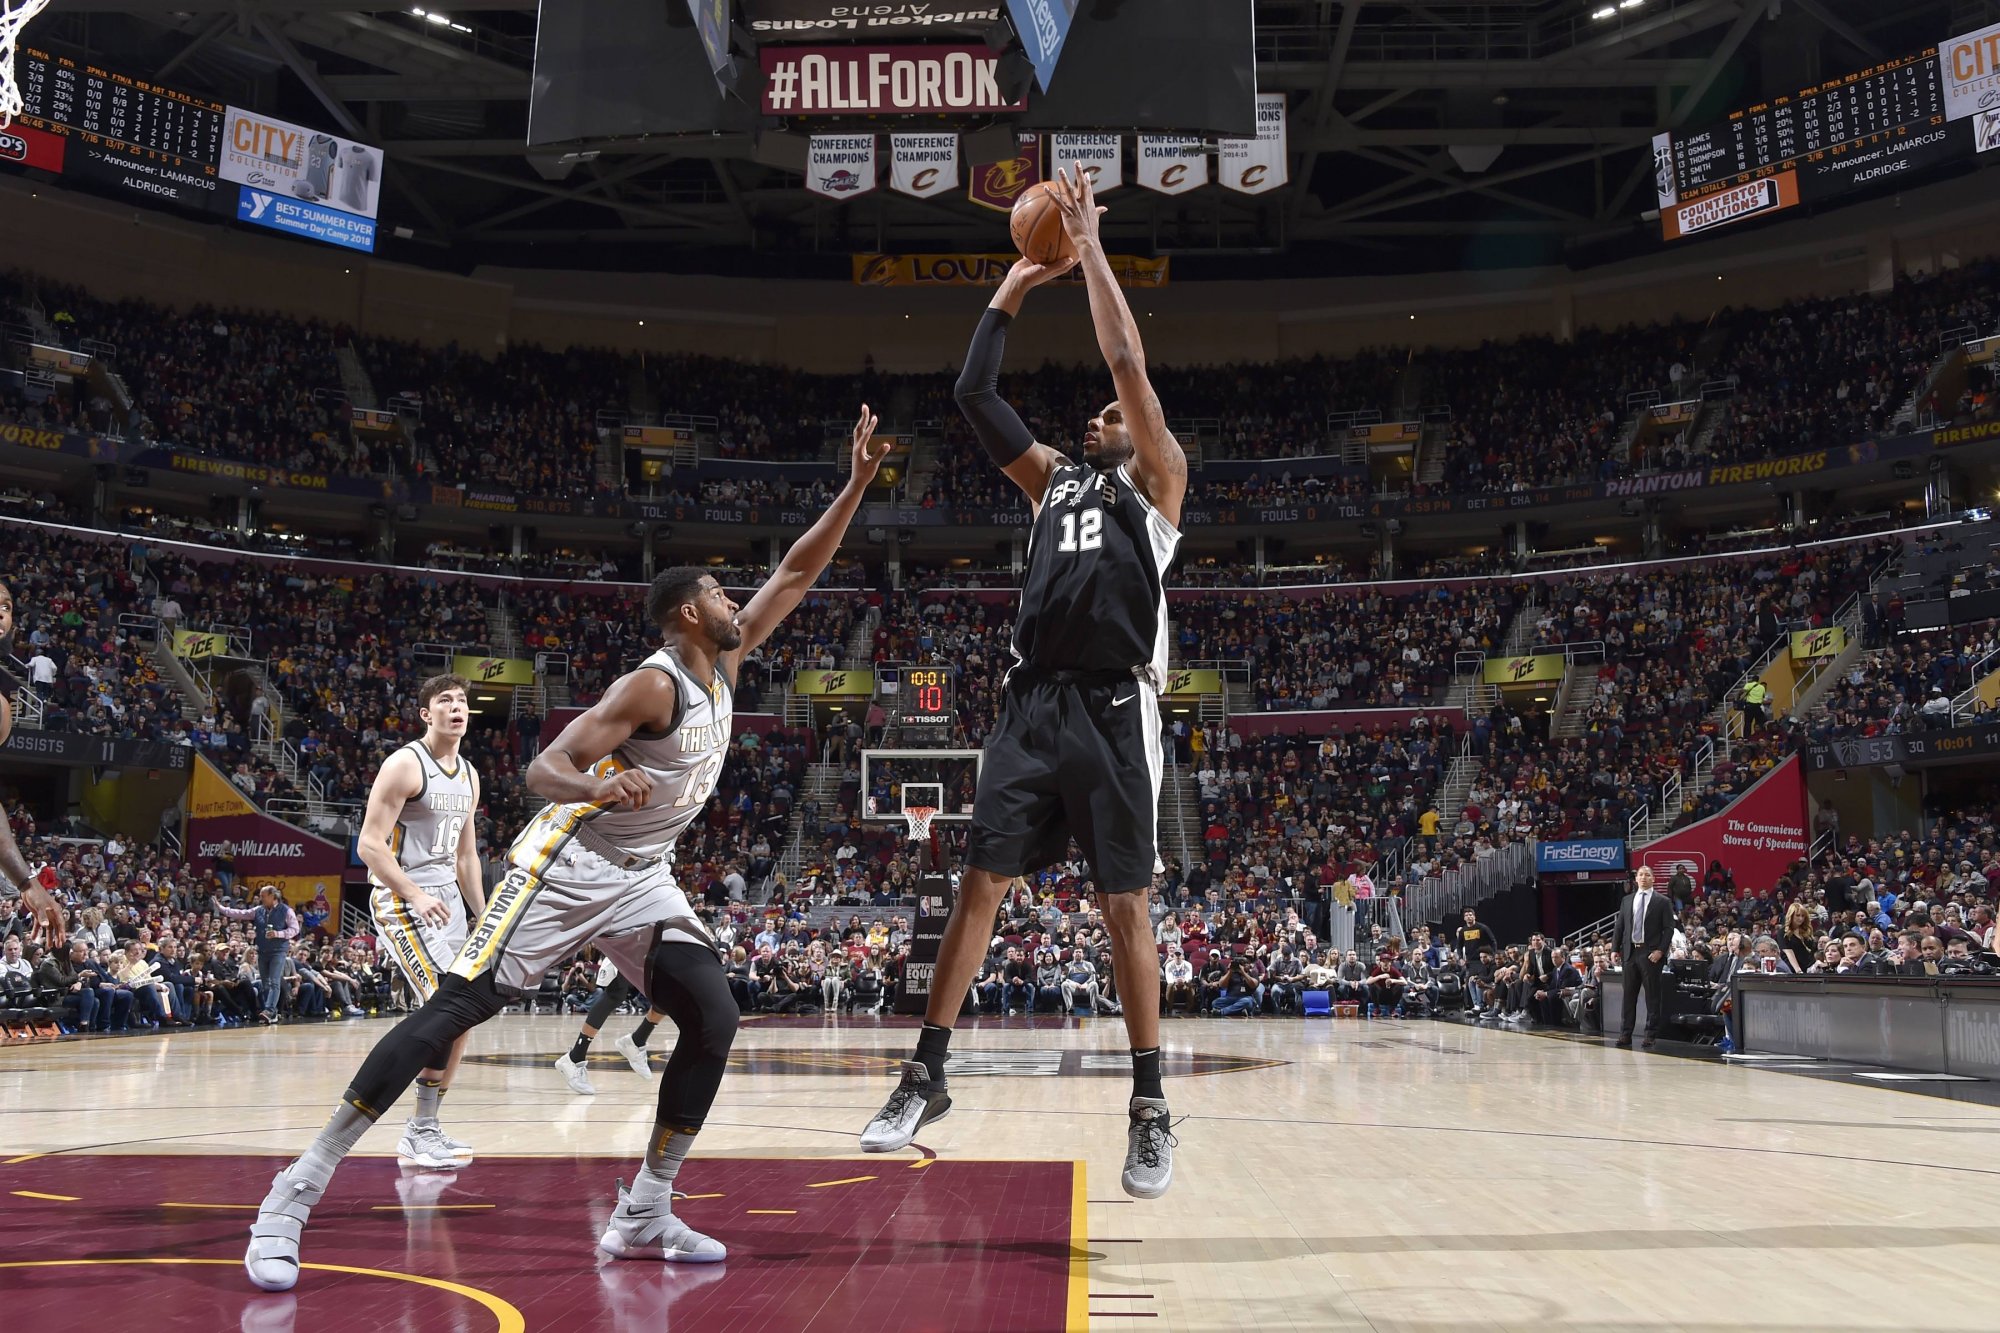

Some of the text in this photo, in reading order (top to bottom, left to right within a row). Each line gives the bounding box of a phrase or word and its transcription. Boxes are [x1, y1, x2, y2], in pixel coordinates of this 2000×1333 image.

[831, 2, 929, 16] Arena
[752, 18, 848, 32] Loans
[28, 61, 103, 89] 2/5 40% 0/0
[28, 72, 44, 82] 3/9
[55, 80, 74, 92] 33%
[768, 52, 1020, 109] #ALLFORON
[28, 83, 73, 102] 1/3 33%
[24, 104, 68, 122] 0/5 0%
[26, 93, 98, 120] 2/7 29% 1/5
[1674, 141, 1684, 150] 23
[1687, 132, 1710, 146] JAMES
[1732, 122, 1743, 132] 20
[1775, 107, 1792, 118] 64%
[1802, 98, 1816, 109] 2/3
[1827, 92, 1838, 102] 1/2
[1926, 60, 1934, 70] 17
[234, 118, 296, 162] CITY
[1056, 134, 1118, 146] CONFERENCE
[1676, 152, 1684, 160] 16
[1688, 142, 1712, 156] OSMAN
[1776, 117, 1793, 128] 20%
[1827, 101, 1842, 112] 2/3
[1678, 160, 1686, 168] 13
[1690, 148, 1726, 166] THOMPSON
[1736, 142, 1744, 151] 16
[1777, 127, 1794, 138] 50%
[1804, 119, 1819, 130] 0/0
[1828, 112, 1842, 122] 0/0
[1850, 106, 1860, 115] 12
[811, 138, 872, 149] CONFERENCE
[894, 136, 955, 148] CONFERENCE
[1690, 162, 1712, 176] SMITH
[1806, 130, 1820, 140] 0/5
[1830, 122, 1844, 132] 0/0
[1832, 130, 1946, 171] Announcer: LAMARCUS
[813, 152, 870, 164] CHAMPIONS
[896, 151, 952, 162] CHAMPIONS
[1058, 148, 1114, 160] CHAMPIONS
[1691, 174, 1706, 186] HILL
[1830, 132, 1845, 142] 0/0
[104, 154, 216, 190] Announcer: LAMARCUS
[229, 153, 298, 178] COLLECTION
[1853, 160, 1910, 183] ALDRIDGE.
[122, 176, 180, 198] ALDRIDGE.
[1680, 188, 1699, 200] TEAM
[1700, 181, 1727, 195] TOTALS
[242, 201, 252, 210] the
[1680, 182, 1766, 220] COUNTERTOP
[276, 202, 373, 235] BEST SUMMER EVER
[1688, 196, 1759, 228] SOLUTIONS
[275, 214, 371, 246] Summer Day Camp 2018
[0, 425, 64, 450] ORKS
[172, 454, 328, 488] FIREWORKS COM
[1605, 452, 1828, 497] PHANTOM FIREWORKS
[464, 500, 520, 512] FIREWORKS
[468, 492, 516, 504] PHANTOM
[1433, 500, 1450, 512] PM
[1467, 498, 1488, 510] DET
[1510, 495, 1531, 506] CHA
[641, 506, 684, 520] TOL: 5
[704, 509, 742, 522] FOULS
[780, 512, 806, 524] FG%
[898, 512, 918, 524] 53
[991, 512, 1032, 524] 10:01
[1186, 510, 1237, 524] FG% 34
[1260, 508, 1299, 522] FOULS
[1338, 504, 1382, 518] TOL: 4
[1058, 508, 1102, 552] 12
[190, 637, 214, 656] ICE
[1809, 630, 1832, 656] ICE
[483, 661, 506, 680] ICE
[911, 671, 946, 686] 10:01
[1514, 658, 1536, 681] ICE
[825, 673, 847, 694] ICE
[1171, 672, 1192, 692] ICE
[919, 686, 942, 711] 10
[914, 716, 949, 724] TISSOT
[6, 736, 64, 754] ASSISTS
[680, 726, 707, 752] THE
[1908, 740, 1925, 754] 3Q
[1935, 736, 1974, 752] 10:01
[1985, 734, 1998, 744] 11
[102, 742, 115, 762] 11
[1869, 741, 1894, 762] 53
[169, 755, 185, 768] 35
[672, 751, 722, 807] 13
[214, 801, 226, 812] THE
[226, 800, 245, 812] TOWN
[428, 792, 448, 812] THE
[429, 815, 462, 854] 16
[1728, 819, 1803, 836] The Convenience
[1544, 844, 1618, 860] FirstEnergy
[1722, 833, 1809, 852] Stores of Speedway
[930, 896, 943, 907] NBA
[464, 872, 527, 960] CAVALIERS
[394, 929, 430, 988] CAVALIERS
